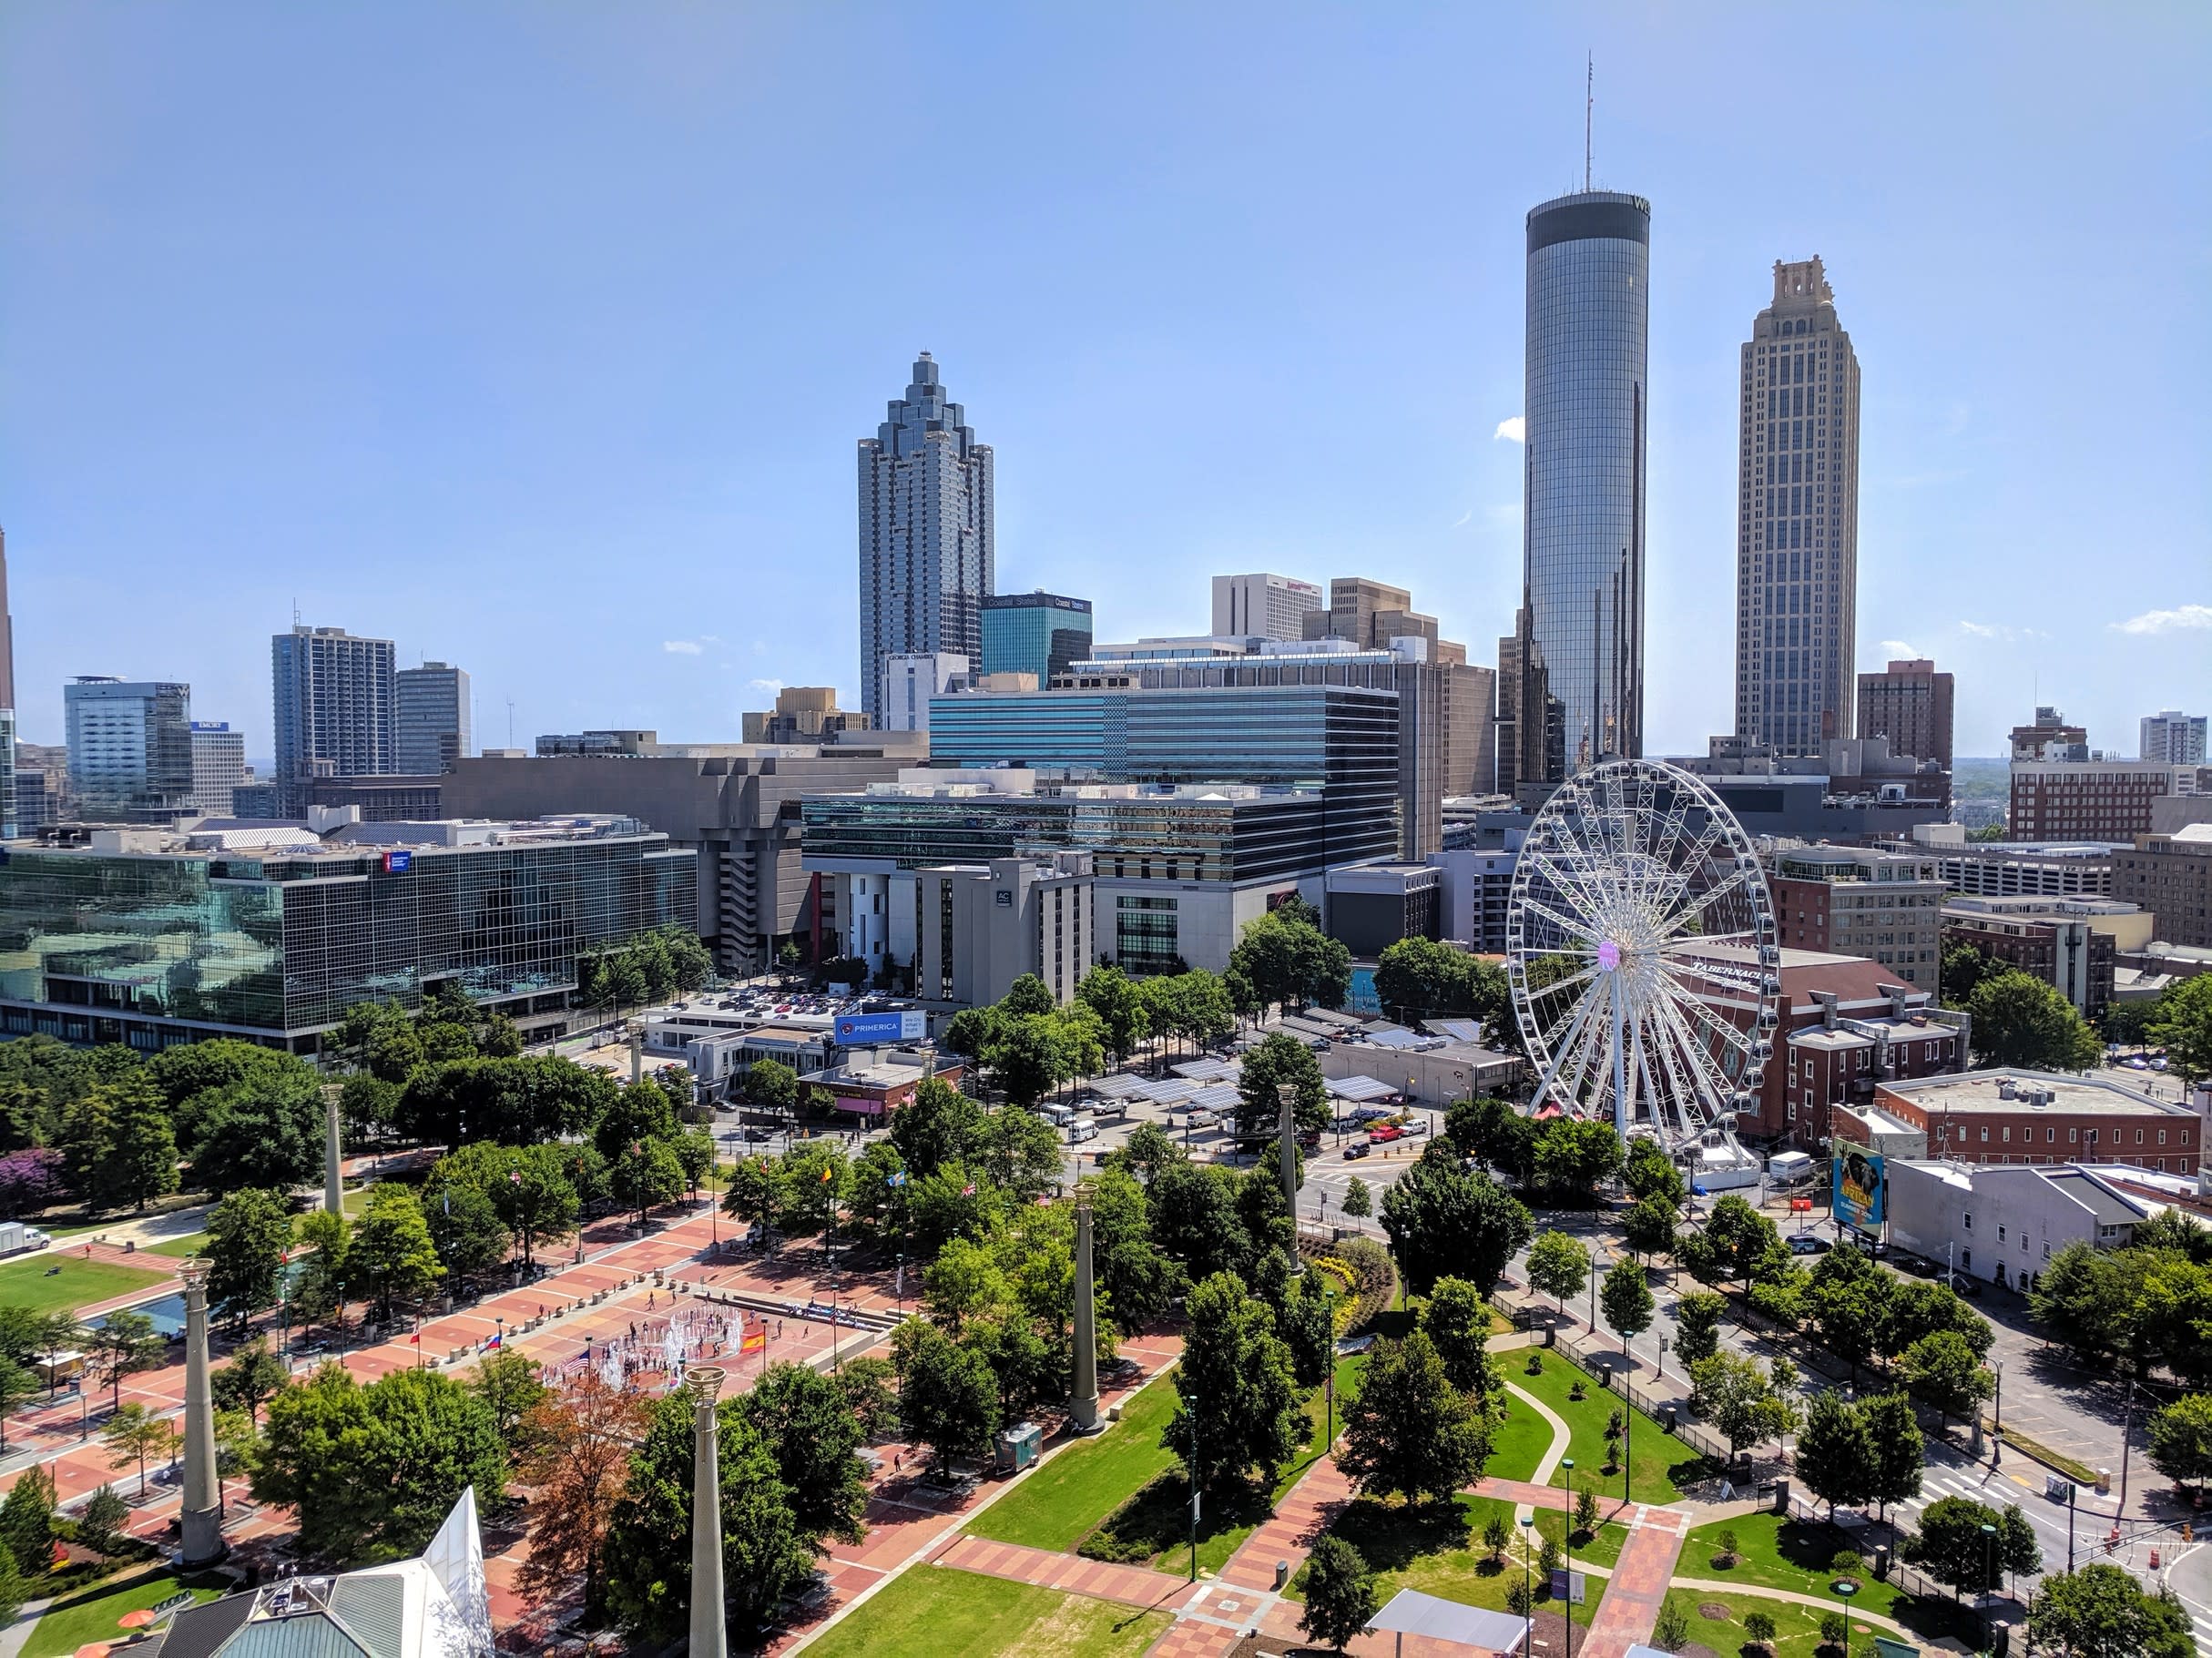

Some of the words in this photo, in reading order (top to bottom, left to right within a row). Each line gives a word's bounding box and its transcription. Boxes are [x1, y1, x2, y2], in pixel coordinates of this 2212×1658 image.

[988, 597, 1014, 607] Coastal
[1016, 597, 1038, 606] States
[177, 687, 189, 697] W
[854, 1023, 897, 1033] PRIMERICA
